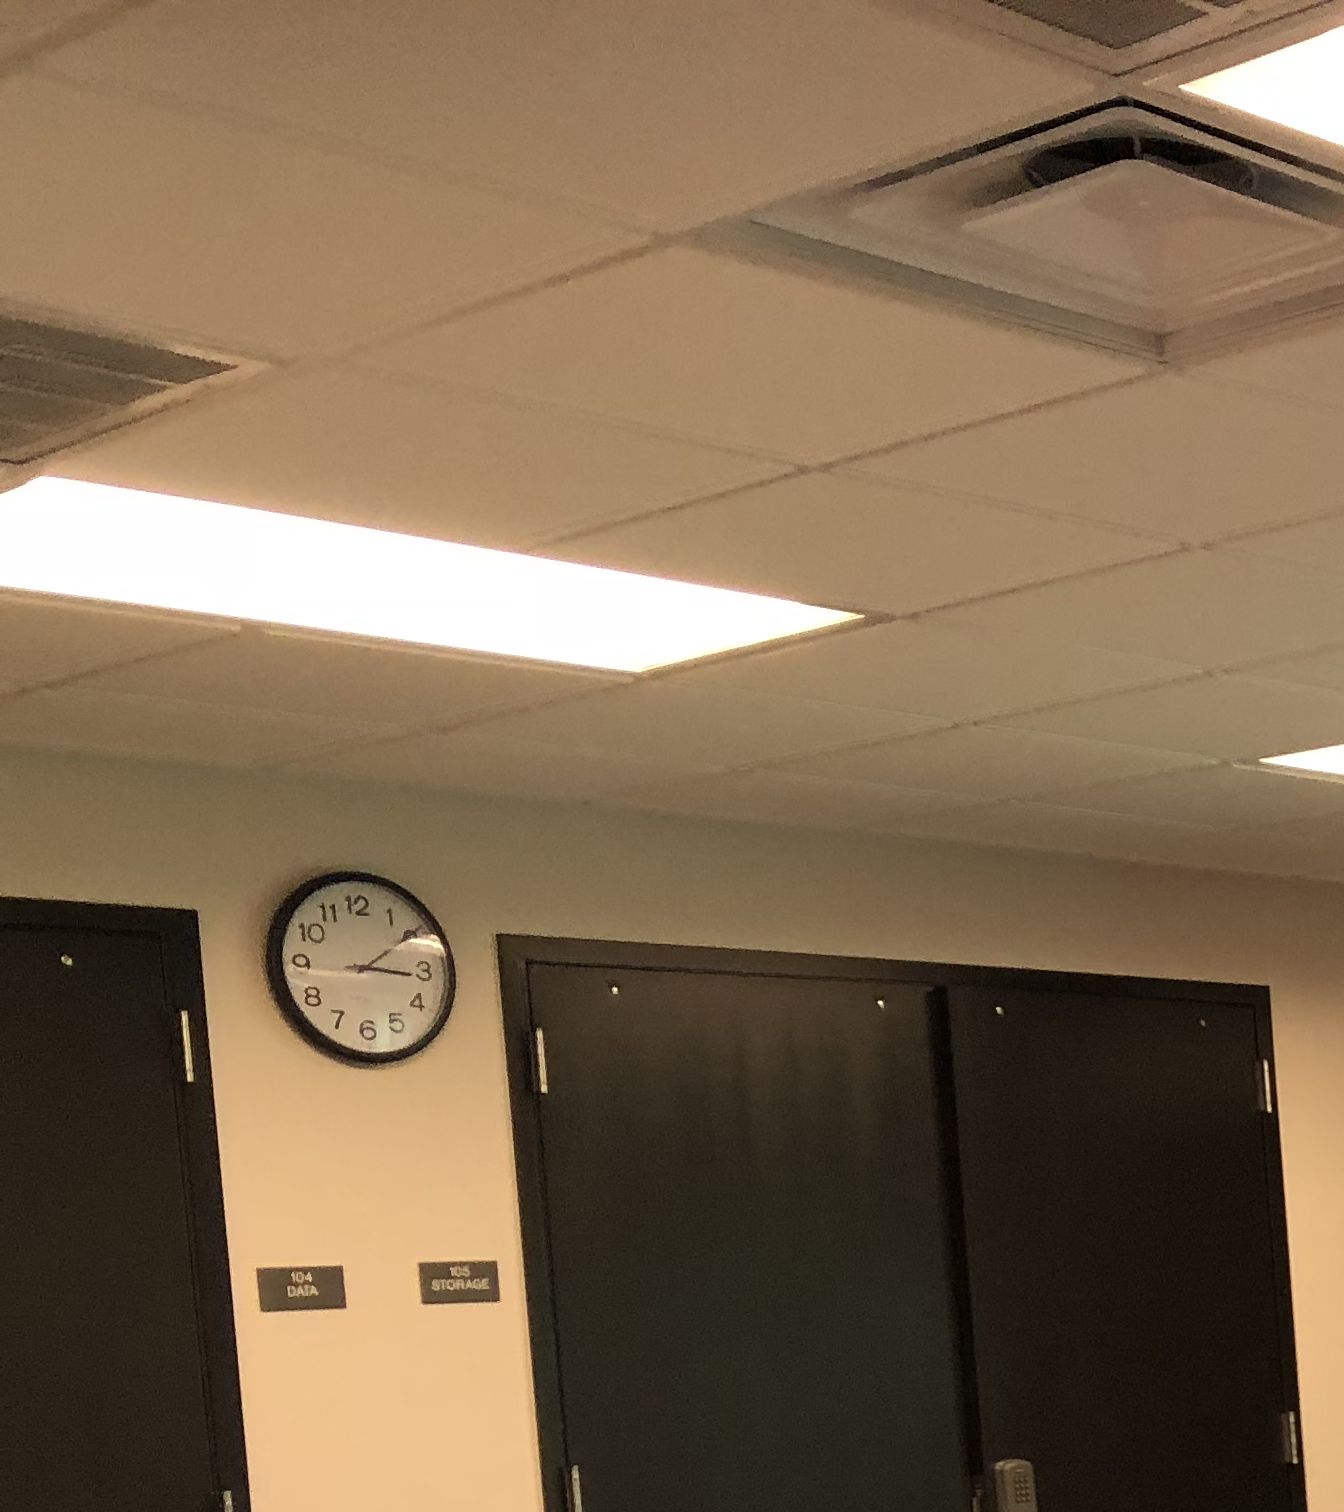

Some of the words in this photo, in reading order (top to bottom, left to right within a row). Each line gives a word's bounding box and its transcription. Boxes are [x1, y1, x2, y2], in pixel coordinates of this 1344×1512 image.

[319, 902, 337, 923] 11
[345, 895, 370, 916] 12
[386, 908, 394, 927] 1
[298, 922, 325, 944] 10
[291, 953, 311, 970] 9
[415, 961, 432, 981] 3
[304, 986, 322, 1007] 8
[409, 992, 425, 1011] 4
[330, 1009, 345, 1029] 7
[388, 1012, 405, 1033] 5
[359, 1020, 376, 1041] 6
[290, 1271, 313, 1284] 104
[450, 1266, 471, 1278] 105
[287, 1285, 319, 1298] DATA
[431, 1278, 490, 1291] STORAGE
